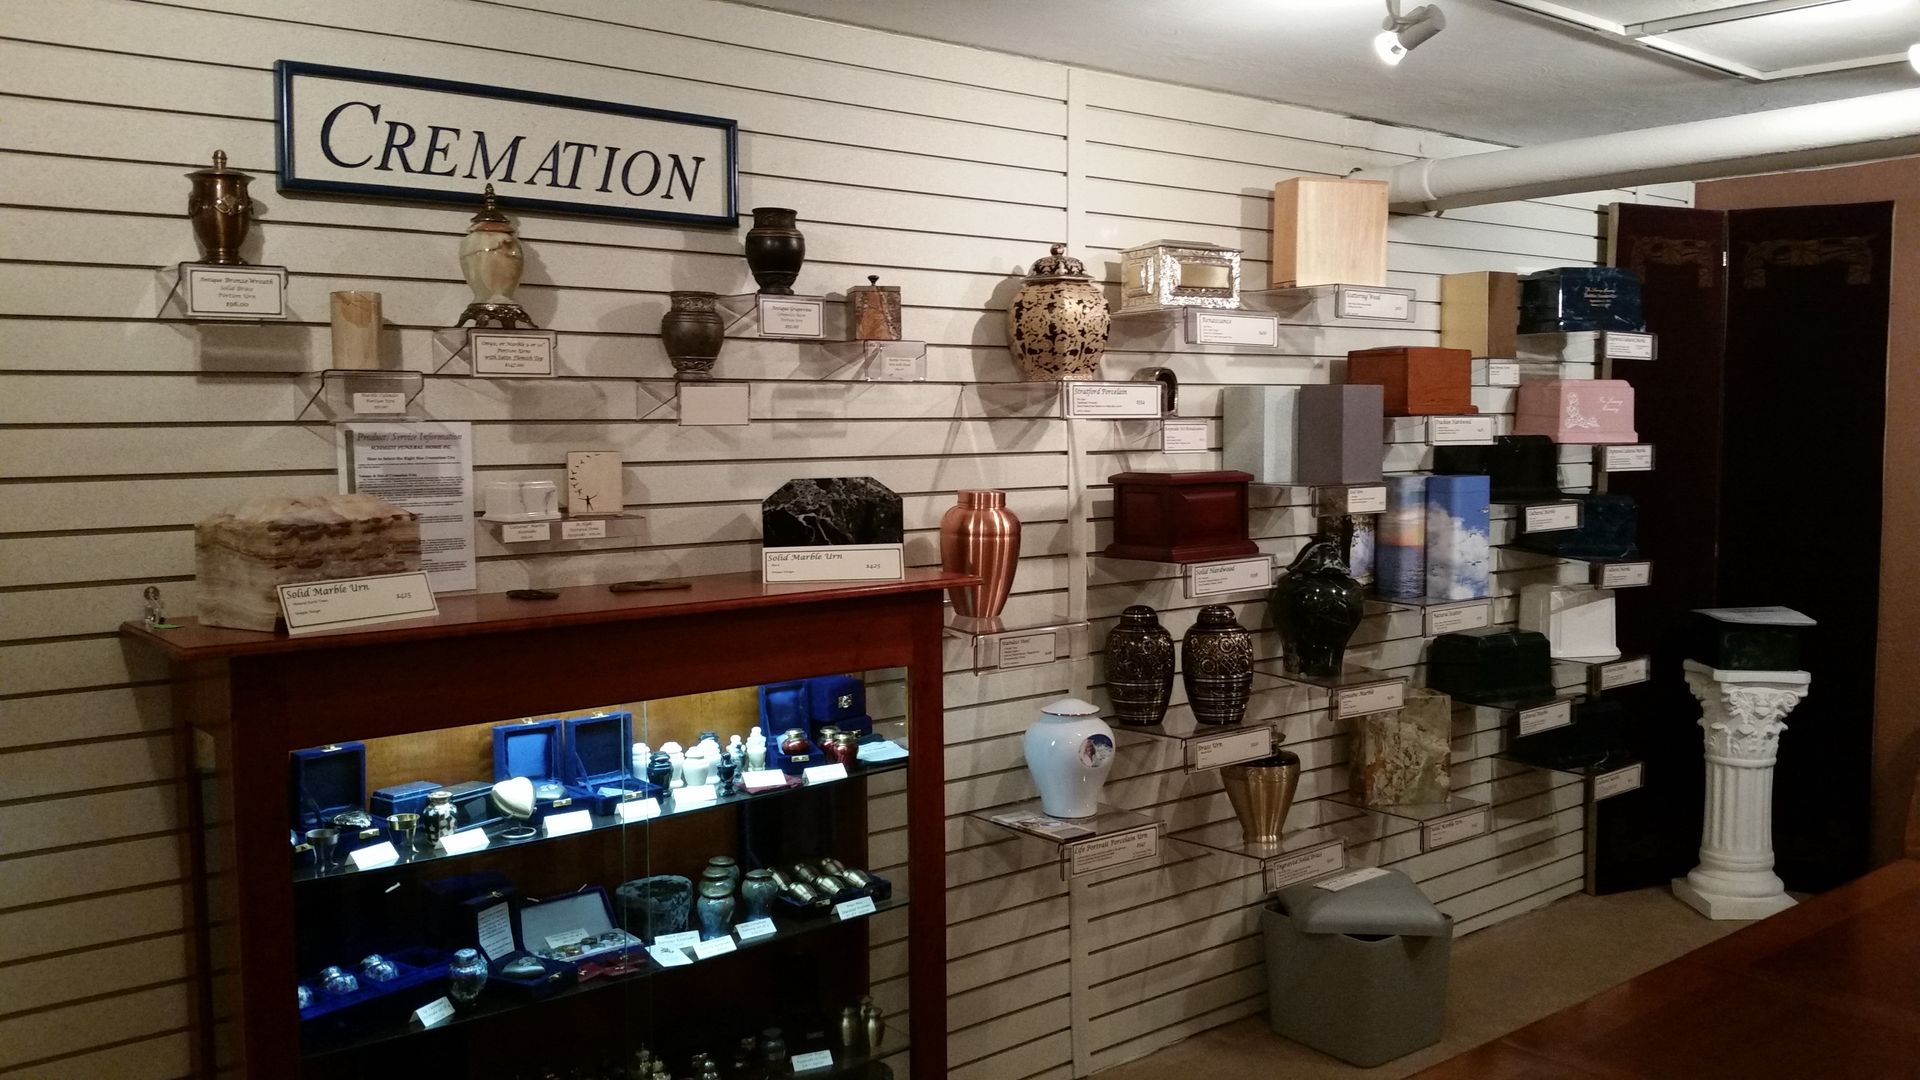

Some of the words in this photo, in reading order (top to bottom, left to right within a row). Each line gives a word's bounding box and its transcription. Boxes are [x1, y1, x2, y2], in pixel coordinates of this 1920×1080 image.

[320, 101, 705, 202] CREMATION
[768, 554, 790, 562] Solid
[286, 588, 311, 600] Solid
[313, 584, 347, 597] Marble
[349, 584, 370, 593] Urn
[1137, 832, 1148, 840] Urn
